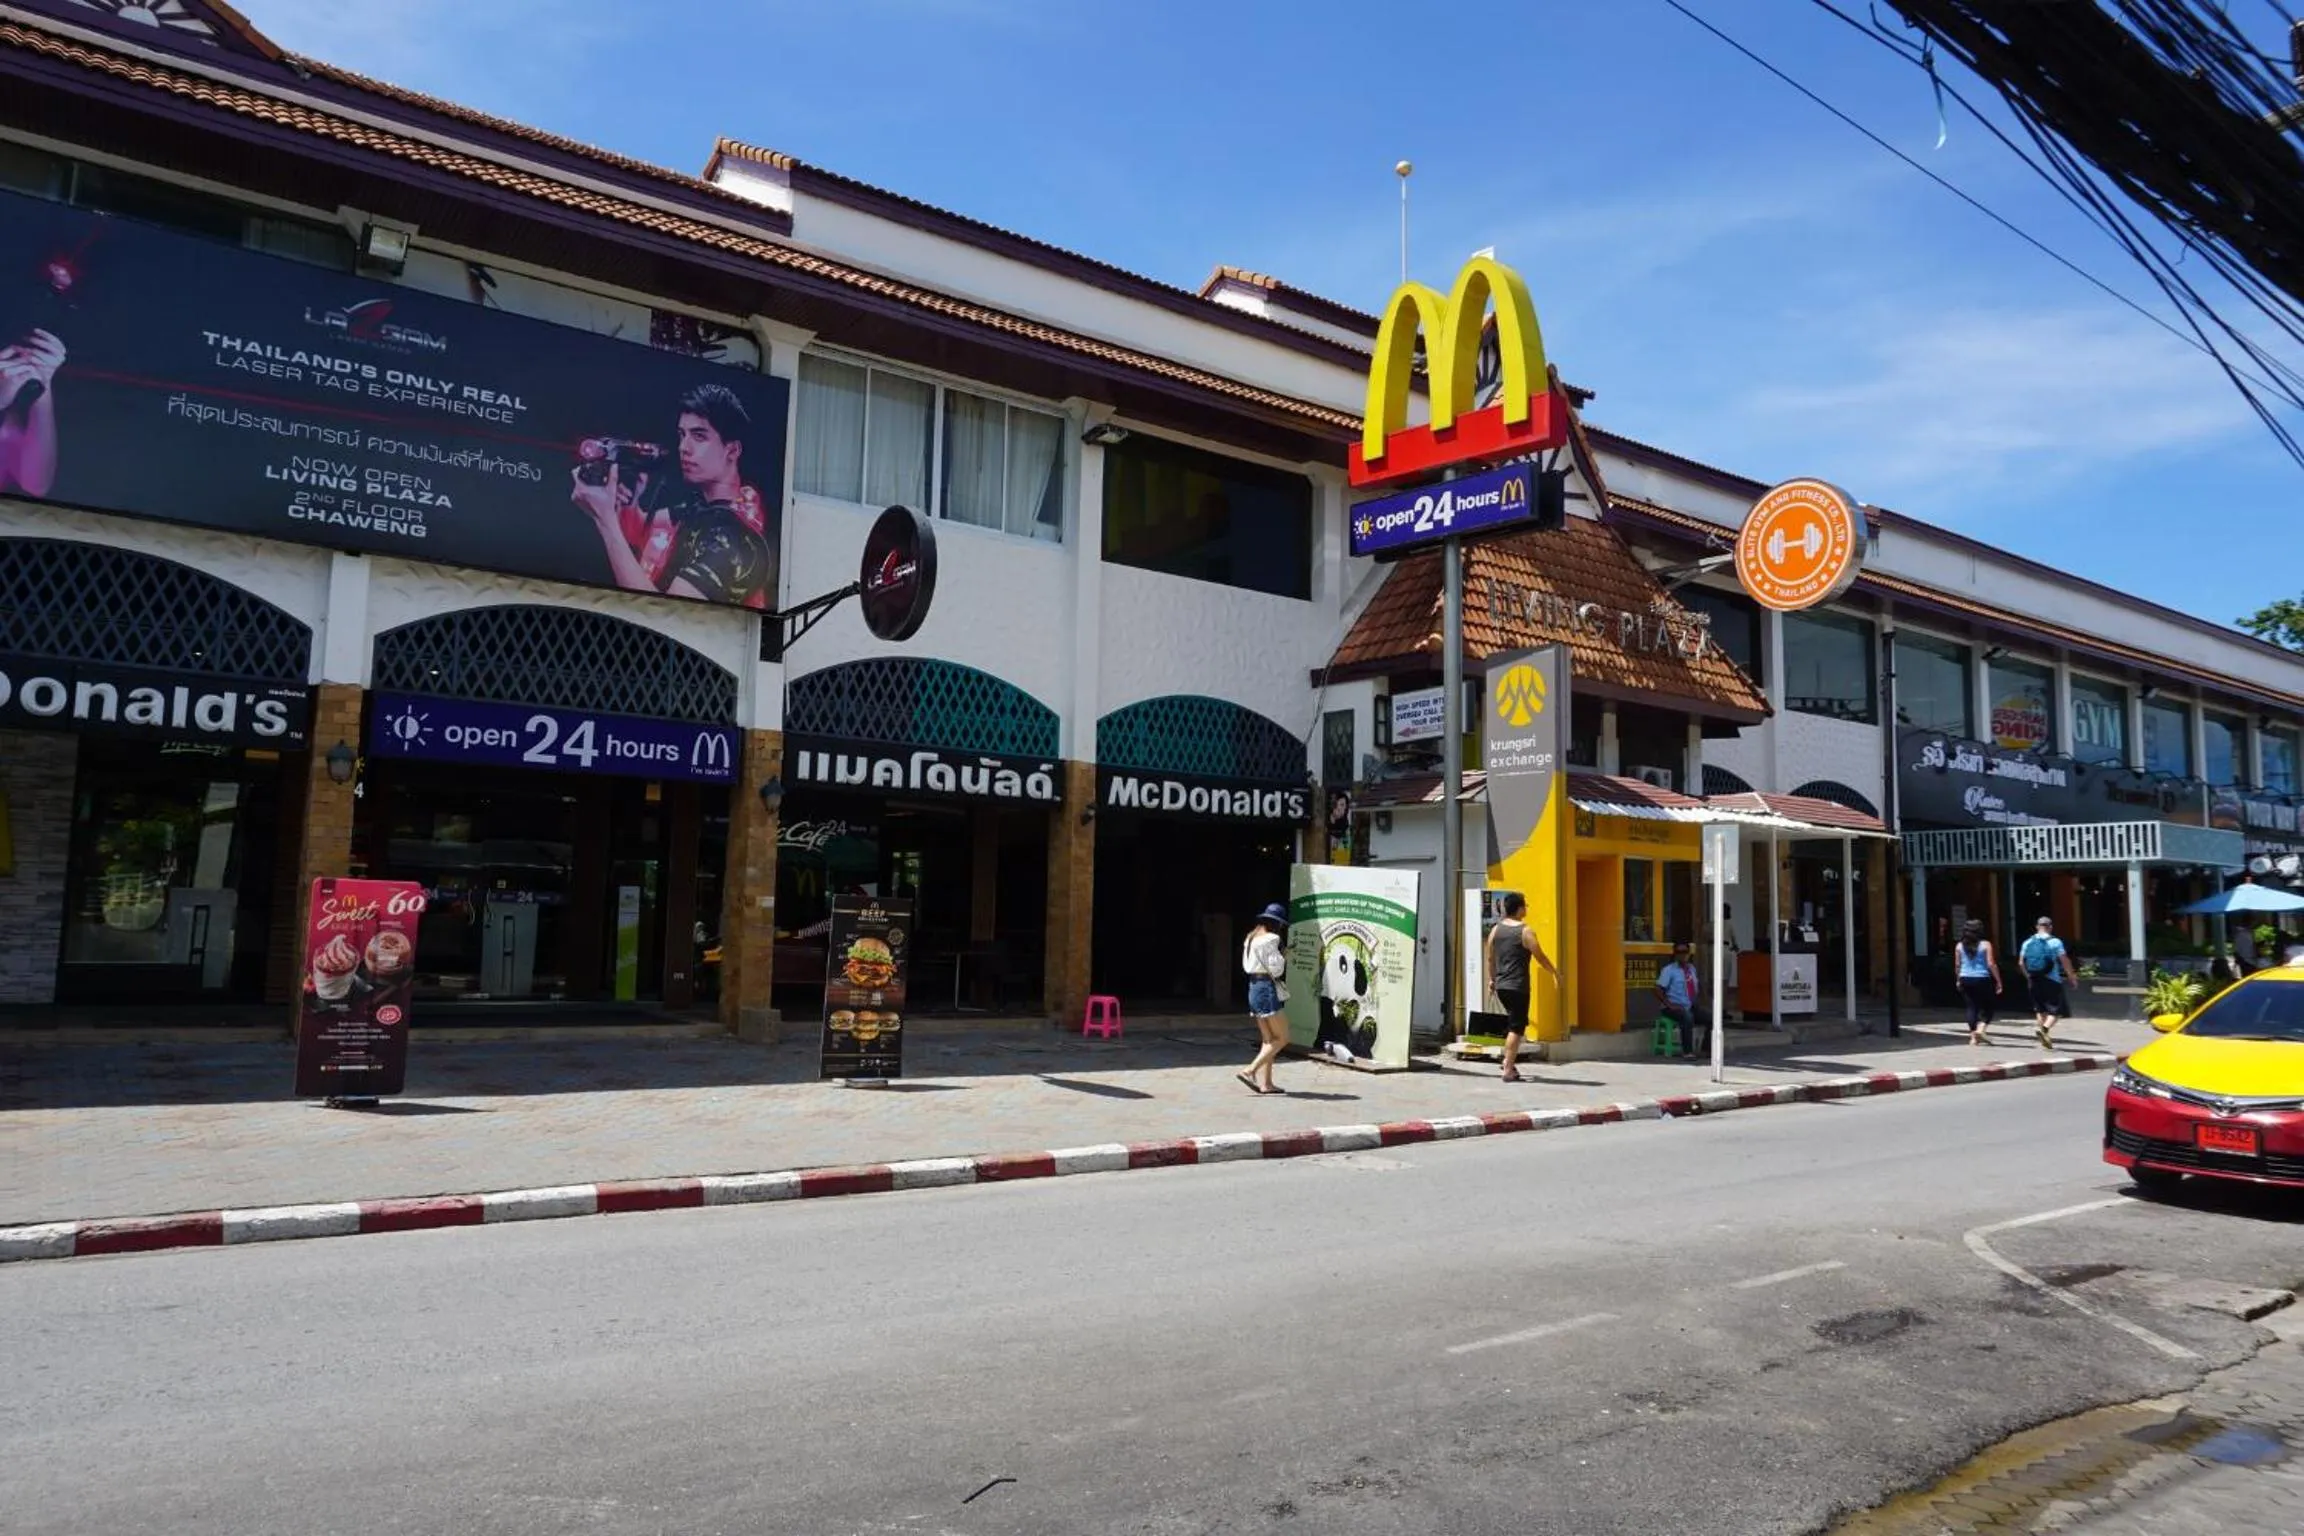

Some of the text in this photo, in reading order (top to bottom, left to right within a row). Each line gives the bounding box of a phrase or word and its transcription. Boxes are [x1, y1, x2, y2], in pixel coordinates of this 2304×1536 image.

[203, 330, 377, 379] THAILAND'S
[386, 370, 454, 394] ONLY
[462, 386, 527, 410] REAL
[215, 352, 515, 424] LASER TAG EXPERIENCE
[265, 465, 453, 509] LIVING PLAZA
[291, 455, 432, 490] NOW OPEN
[294, 491, 423, 523] 2ND FLOOR
[1375, 490, 1500, 533] open 24 hours
[1770, 495, 1789, 508] AND
[1792, 489, 1831, 506] FITNESS
[288, 505, 427, 538] CHAWENG
[1774, 581, 1818, 597] THAILAND
[1488, 578, 1715, 663] LIVING PLAZA
[0, 670, 289, 737] onald's
[2072, 699, 2122, 750] GYM
[444, 714, 680, 768] open 24 hours
[1490, 733, 1537, 752] krungsri
[1490, 753, 1553, 769] exchange
[797, 750, 1055, 801] แมคโดนัลด์
[1107, 775, 1304, 820] McDonald's
[317, 898, 381, 930] Sweet
